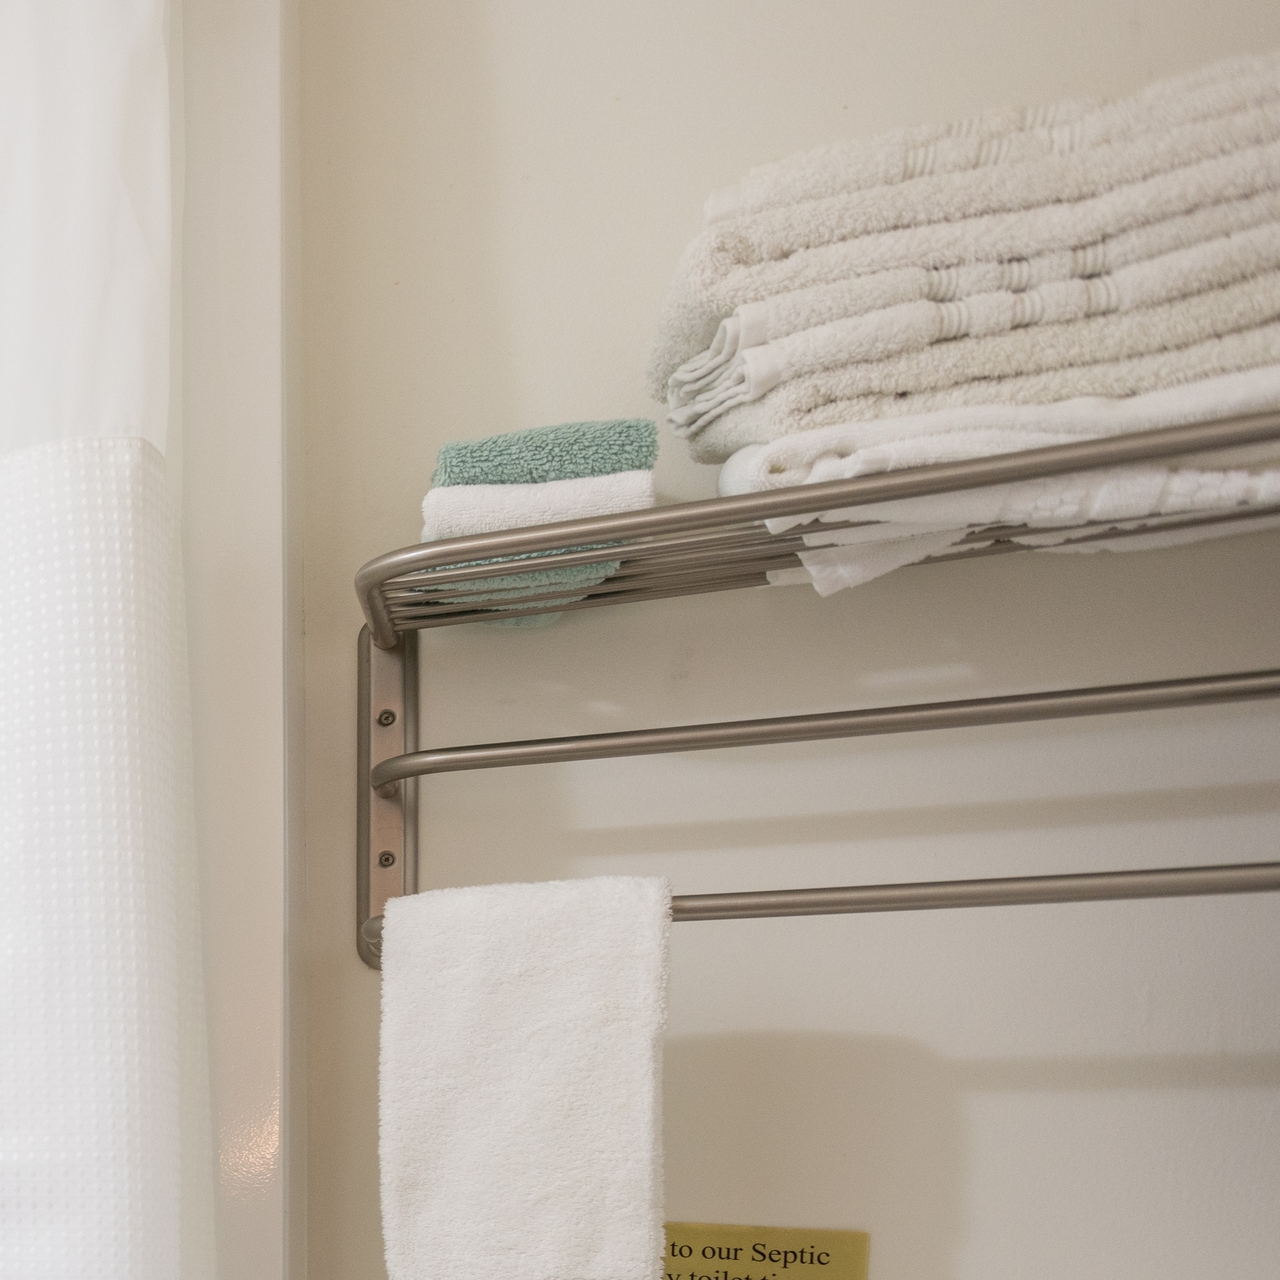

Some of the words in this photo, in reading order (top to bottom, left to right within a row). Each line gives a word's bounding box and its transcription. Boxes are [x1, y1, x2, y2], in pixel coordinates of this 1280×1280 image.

[669, 1241, 693, 1258] to
[701, 1245, 743, 1261] our
[751, 1243, 831, 1269] Septic
